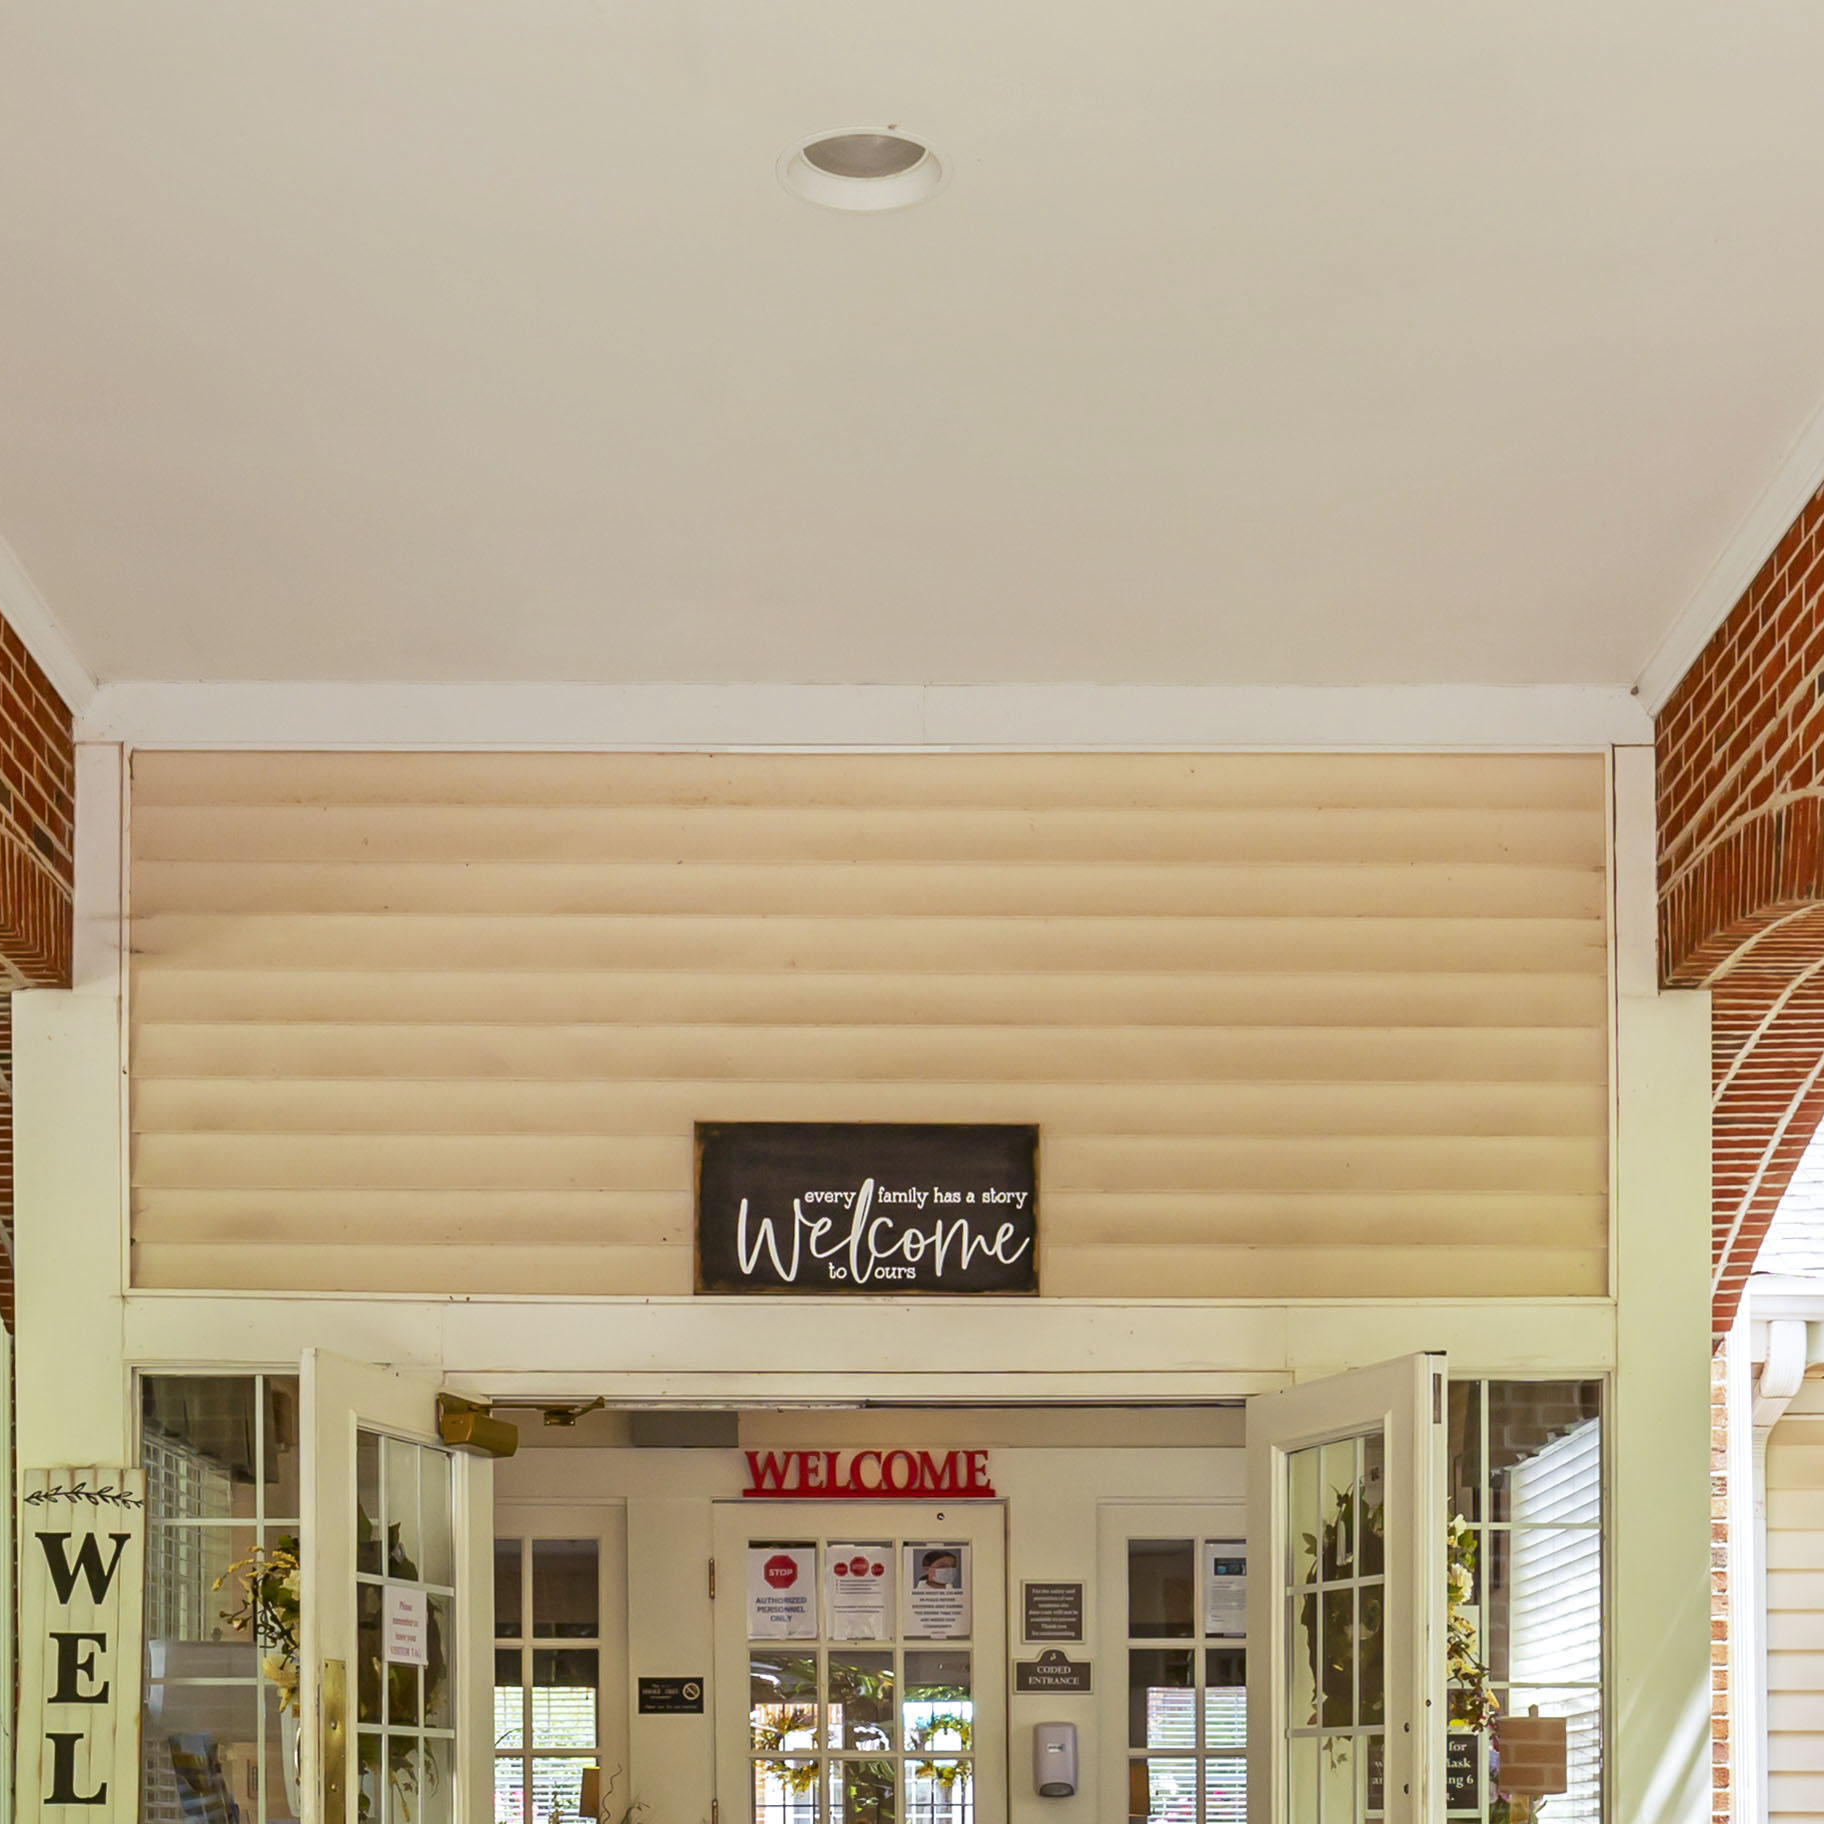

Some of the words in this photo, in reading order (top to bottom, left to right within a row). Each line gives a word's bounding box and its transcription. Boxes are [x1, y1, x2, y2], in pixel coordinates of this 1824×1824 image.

[804, 1190, 856, 1209] every
[877, 1186, 928, 1209] family
[933, 1187, 961, 1204] has
[966, 1190, 976, 1204] a
[981, 1187, 1028, 1209] story
[737, 1177, 1030, 1284] Welcome
[828, 1262, 847, 1279] to
[874, 1263, 916, 1279] ours
[744, 1450, 992, 1491] WELCOME
[769, 1568, 793, 1577] STOP
[1037, 1666, 1071, 1674] CODED
[1029, 1676, 1080, 1685] ENTRANCE
[1448, 1741, 1467, 1751] for
[1467, 1775, 1474, 1785] 6
